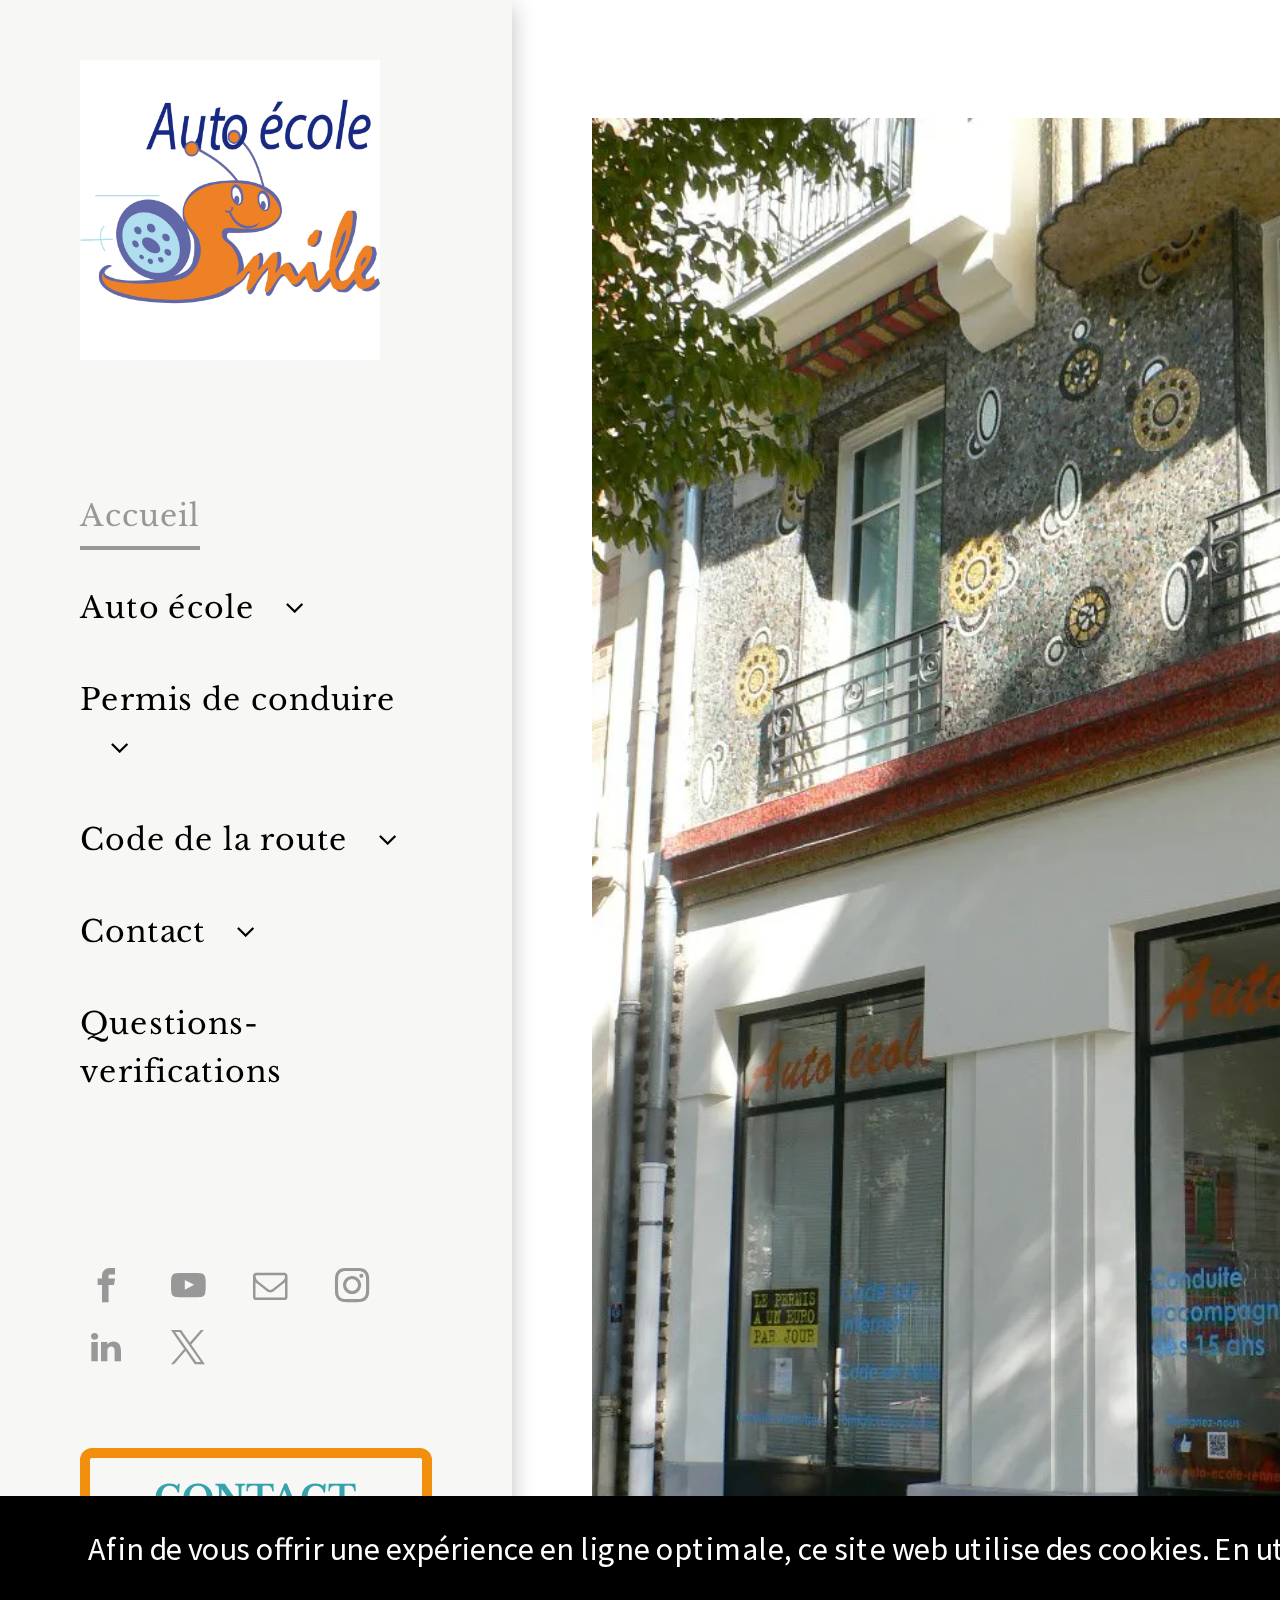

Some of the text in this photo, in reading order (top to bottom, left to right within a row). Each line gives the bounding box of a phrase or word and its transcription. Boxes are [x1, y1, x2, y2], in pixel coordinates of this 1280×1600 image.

[146, 99, 372, 151] Auto école
[80, 501, 198, 526] Accueil
[80, 593, 253, 620] Auto école
[81, 685, 394, 712] Permis de conduire
[81, 825, 346, 852] Code de la route
[81, 917, 205, 944] Contact
[81, 1009, 257, 1043] Questions-
[80, 1056, 280, 1084] verifications
[745, 1040, 833, 1100] Auto
[1150, 1266, 1244, 1290] Conduite
[753, 1291, 816, 1308] LE PERMIS
[753, 1308, 816, 1325] A UN EURO
[753, 1328, 815, 1344] PAR JOUR
[1195, 1333, 1221, 1357] 15
[1225, 1336, 1265, 1357] ans
[87, 1536, 143, 1561] Afin
[150, 1536, 182, 1561] de
[187, 1543, 250, 1561] vous
[256, 1536, 325, 1561] offrir
[331, 1543, 380, 1561] une
[386, 1534, 534, 1568] expérience
[540, 1543, 573, 1561] en
[582, 1536, 650, 1568] ligne
[656, 1536, 791, 1568] optimale,
[798, 1543, 828, 1561] ce
[834, 1536, 886, 1561] site
[892, 1536, 948, 1561] web
[955, 1536, 1040, 1561] utilise
[1046, 1536, 1092, 1561] des
[1098, 1536, 1209, 1561] cookies.
[1216, 1538, 1249, 1561] En
